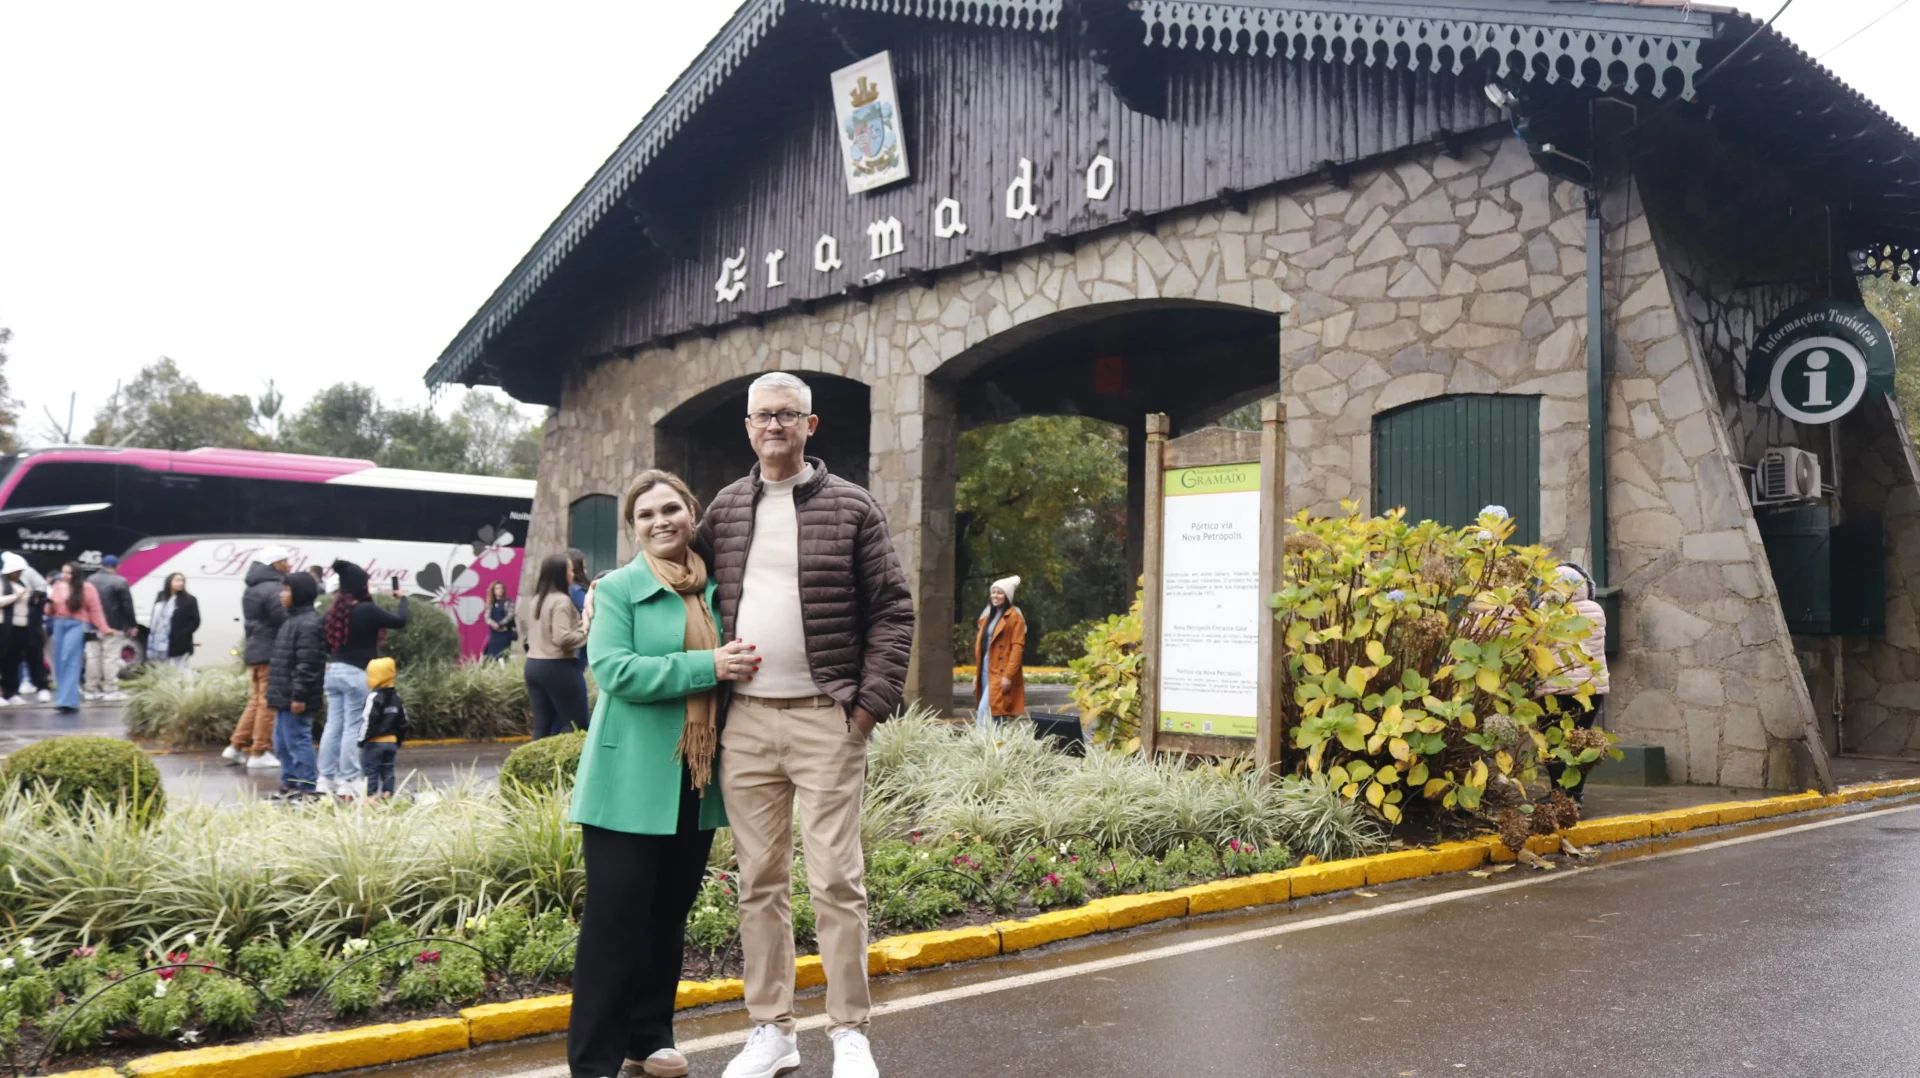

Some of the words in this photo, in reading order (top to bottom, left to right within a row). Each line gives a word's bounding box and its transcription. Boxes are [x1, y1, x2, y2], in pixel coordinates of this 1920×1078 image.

[1759, 312, 1825, 354] Informações
[1828, 309, 1878, 347] Turísticas
[1191, 521, 1219, 531] Pórtico
[1182, 533, 1201, 541] Nova
[1203, 531, 1242, 542] Petrópolis
[78, 550, 102, 565] 4G
